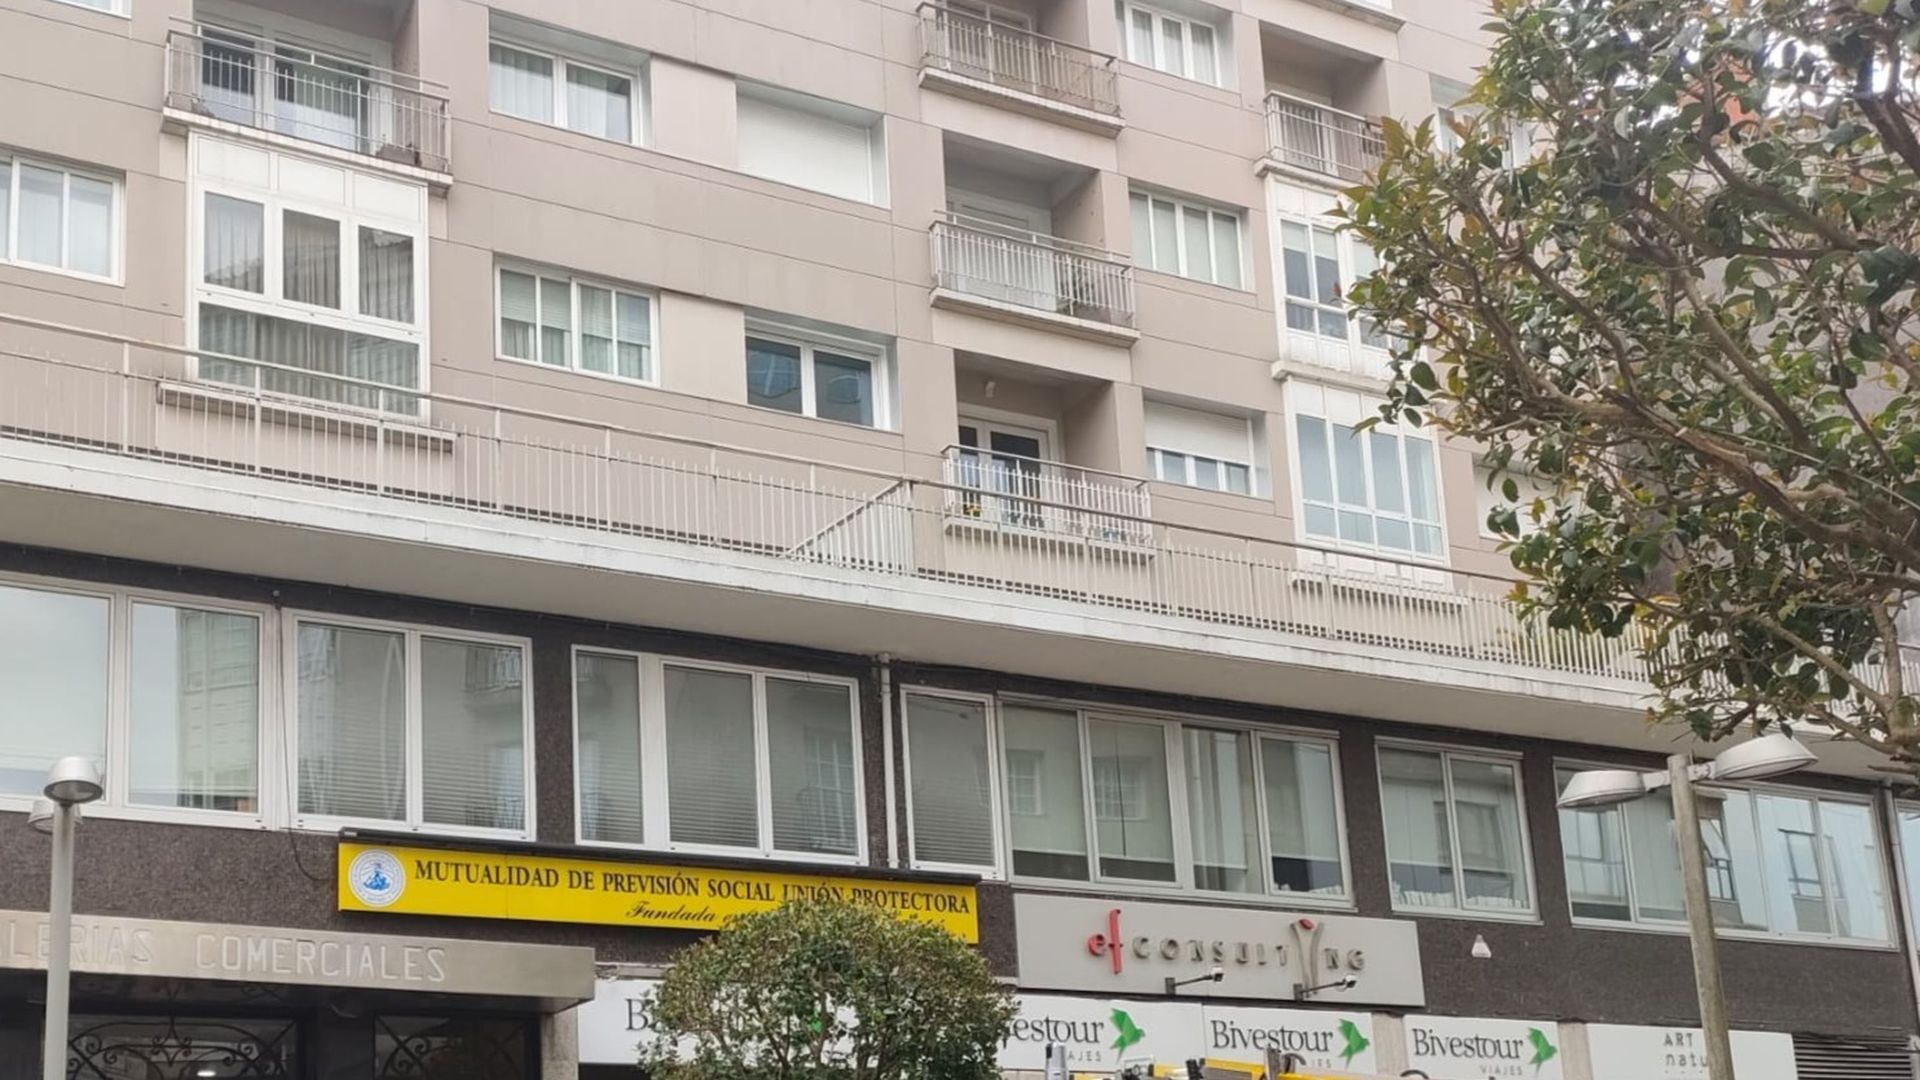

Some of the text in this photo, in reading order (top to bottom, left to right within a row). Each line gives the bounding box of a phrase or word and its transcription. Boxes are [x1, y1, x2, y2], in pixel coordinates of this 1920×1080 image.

[415, 859, 559, 888] MUTUALIDAD
[568, 870, 594, 890] DE
[602, 872, 700, 897] PREVISIÓN
[707, 879, 775, 901] SOCIAL
[850, 887, 971, 914] PROTECTORA
[625, 900, 717, 923] Fundada
[196, 934, 446, 983] COMERCIALES
[1010, 1015, 1104, 1043] estour
[1211, 1020, 1334, 1052] Bivestour
[1664, 1032, 1693, 1047] ART
[1067, 1050, 1102, 1062] AJES
[1412, 1028, 1523, 1059] Bivestour
[1480, 1065, 1523, 1076] VIAJES
[1666, 1052, 1709, 1067] natu
